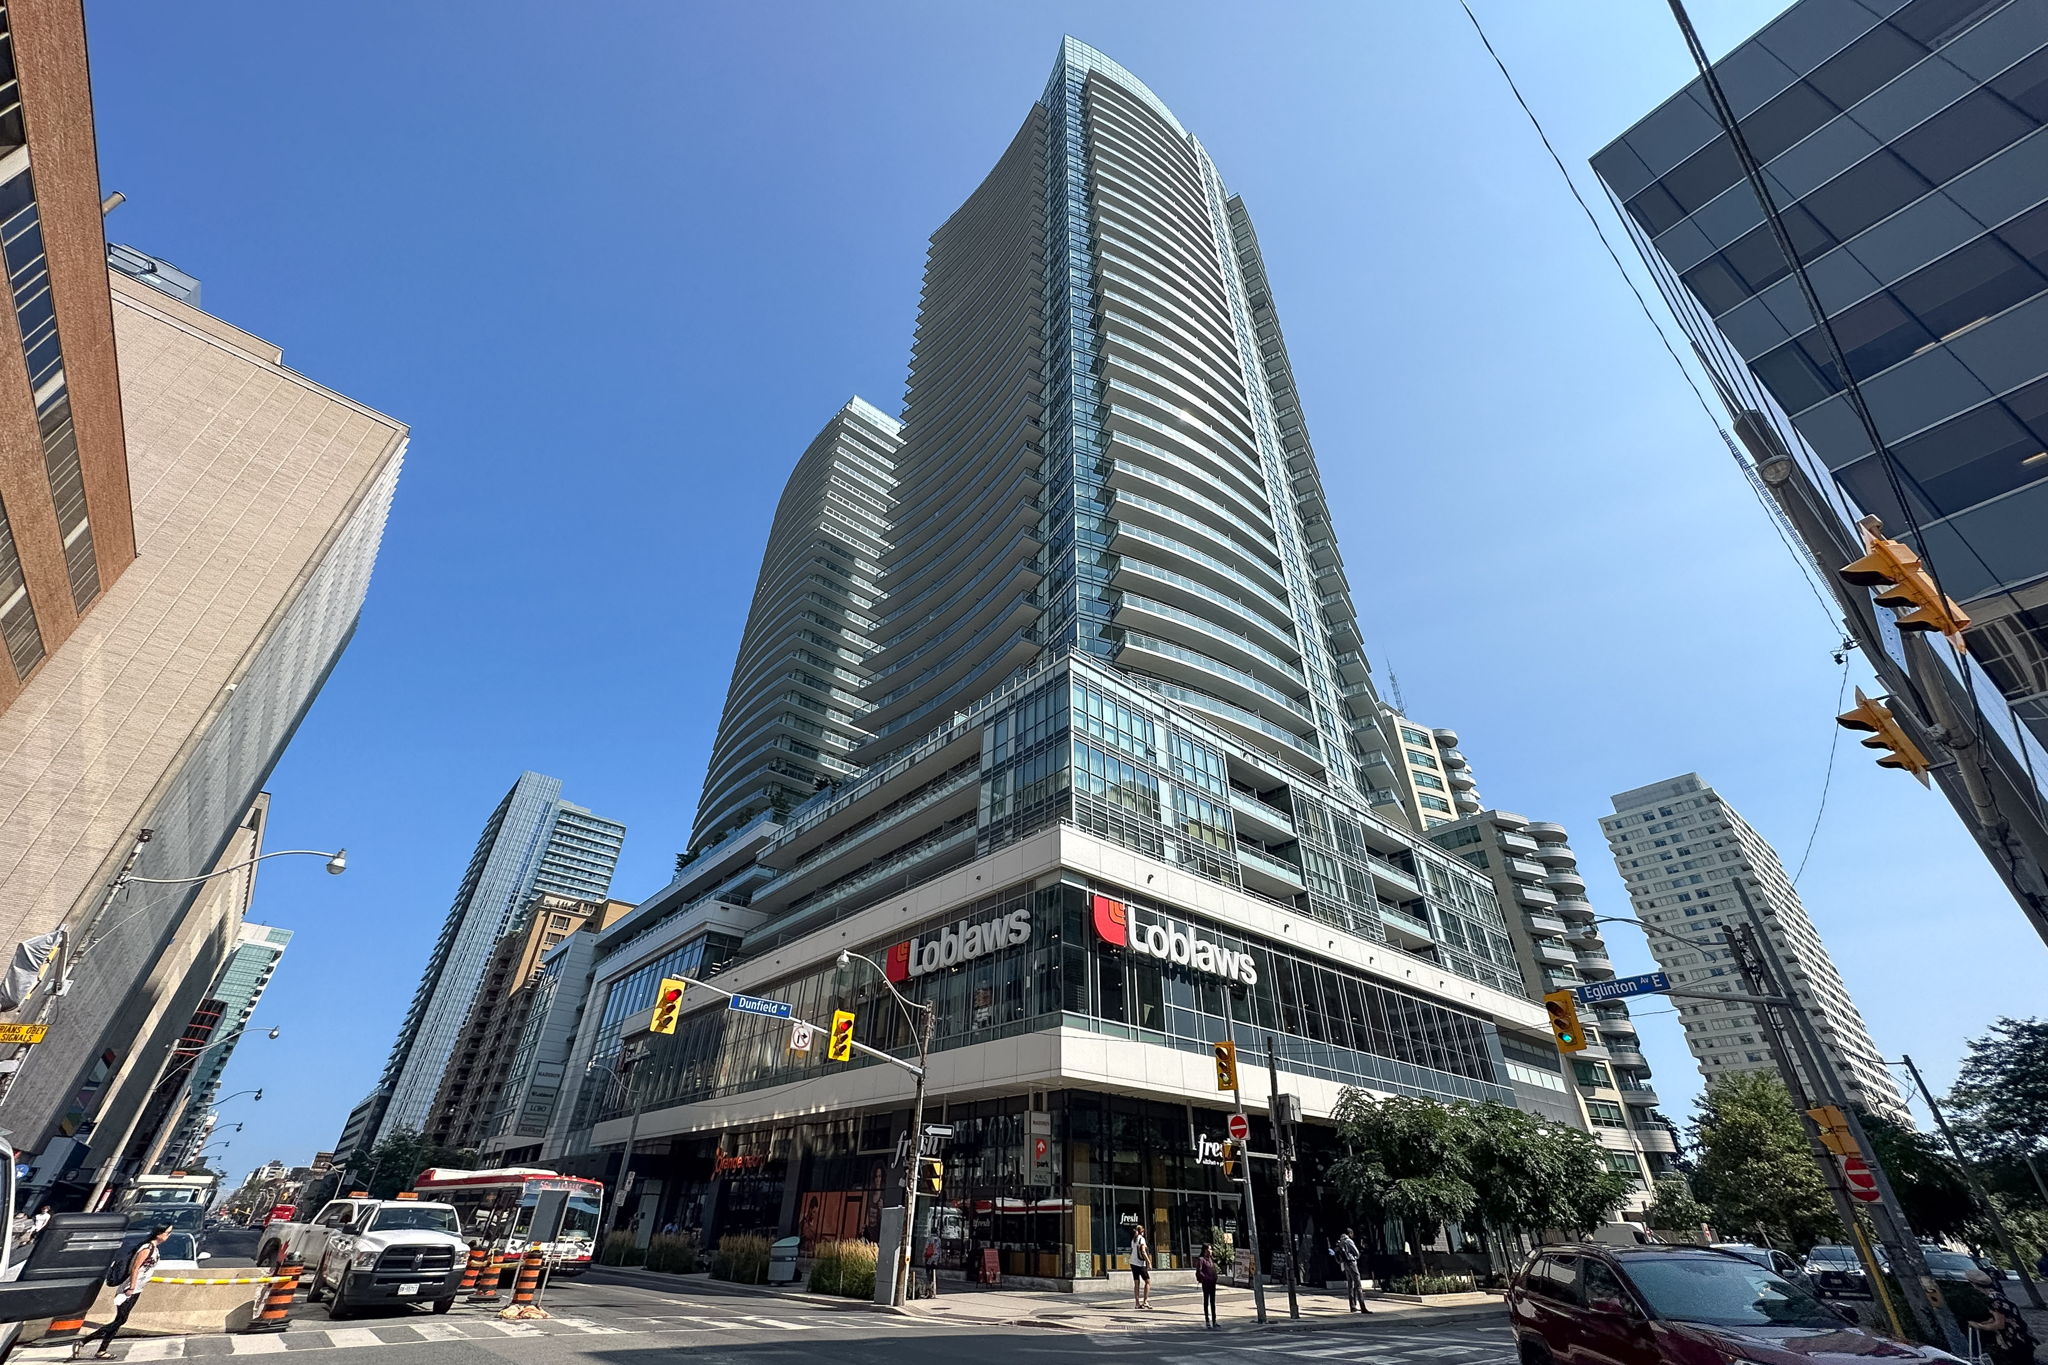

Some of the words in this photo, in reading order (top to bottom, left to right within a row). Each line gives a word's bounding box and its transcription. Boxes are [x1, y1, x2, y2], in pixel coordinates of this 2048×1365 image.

[908, 909, 1031, 977] Loblaws
[1127, 905, 1258, 985] Loblaws
[1583, 981, 1638, 1000] Eglinton
[1640, 976, 1649, 984] Av
[1651, 974, 1663, 987] E
[739, 997, 778, 1013] Dunfield
[1, 1033, 34, 1041] SIGNALS
[26, 1026, 46, 1034] OBEY
[1120, 1212, 1138, 1225] fresh
